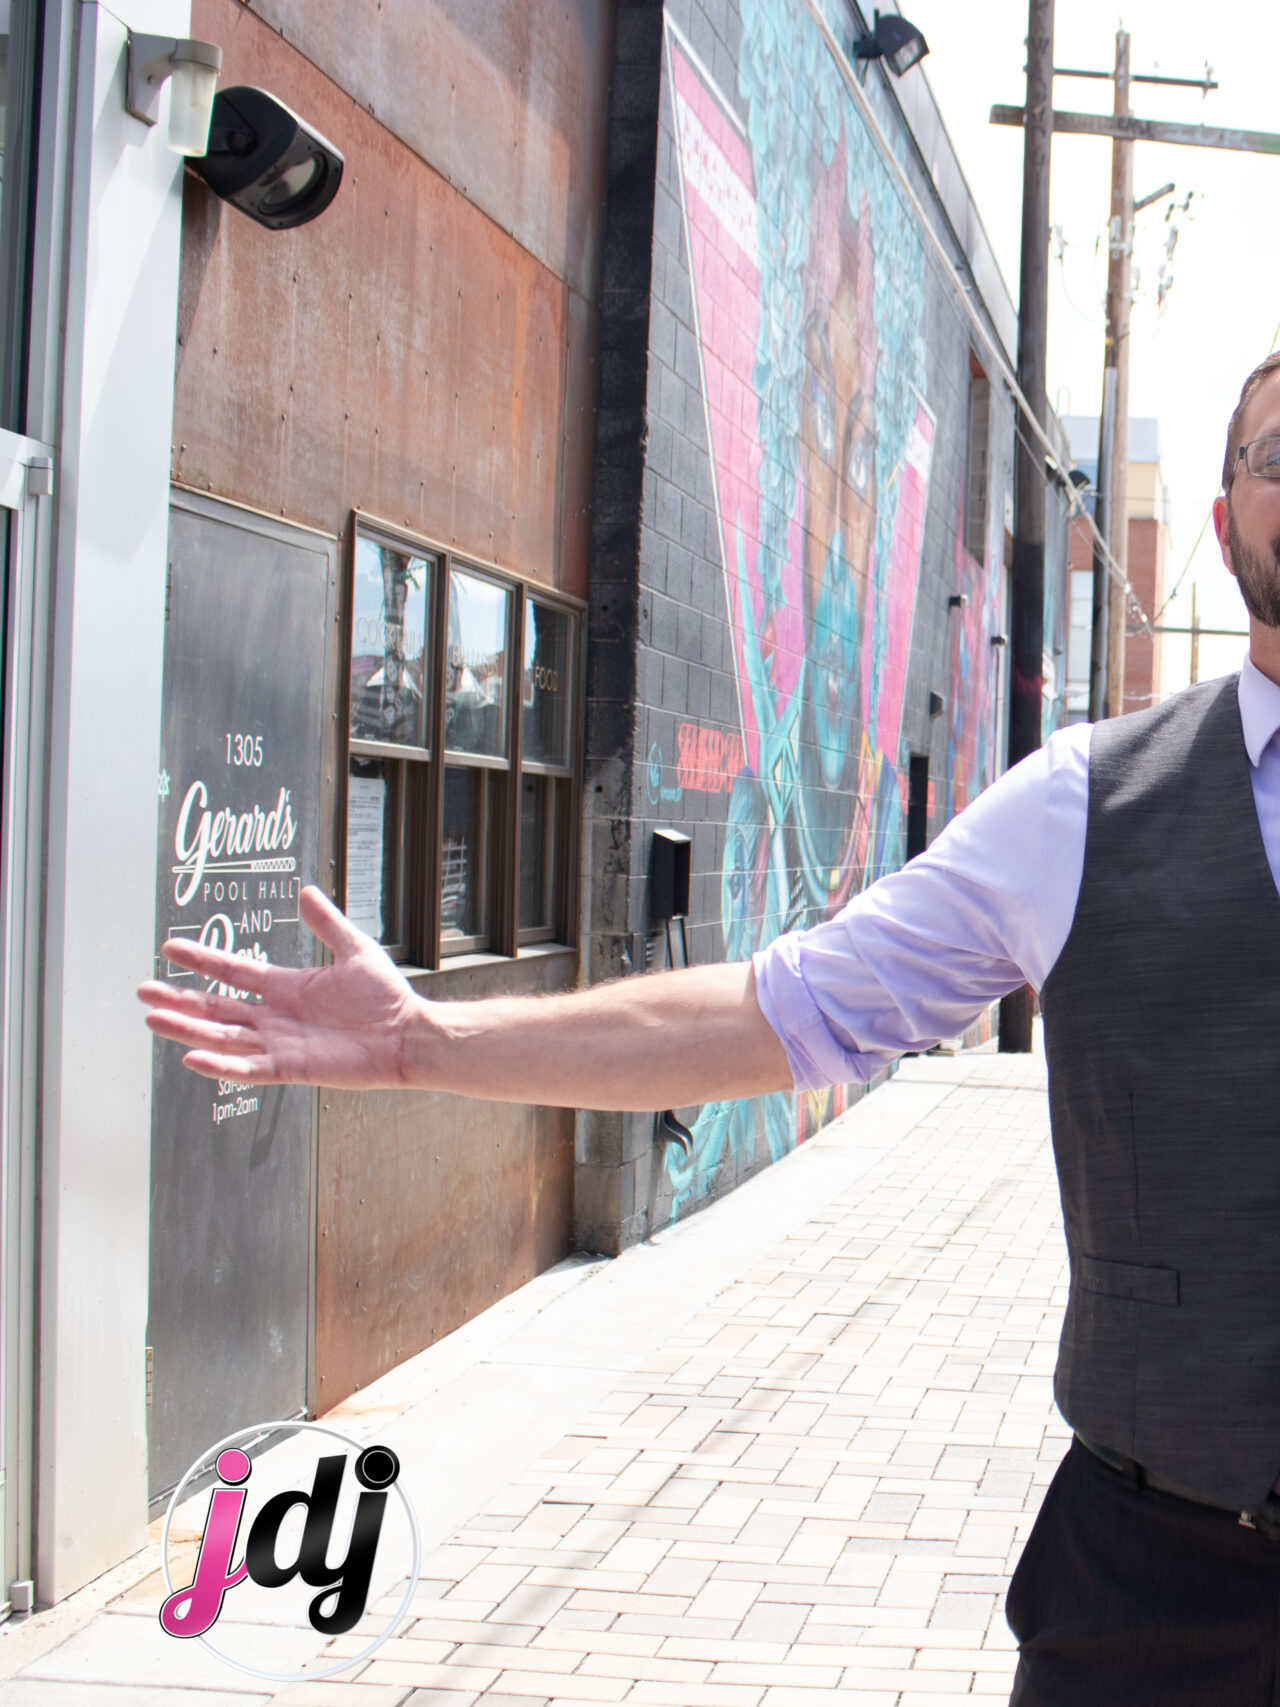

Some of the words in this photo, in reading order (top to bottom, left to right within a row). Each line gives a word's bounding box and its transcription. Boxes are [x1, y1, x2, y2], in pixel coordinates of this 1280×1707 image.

[534, 665, 559, 692] FOOD
[225, 733, 264, 767] 1305
[174, 781, 297, 906] Gerard's
[204, 881, 248, 902] POOL
[258, 878, 295, 900] HALL
[239, 909, 272, 934] AND
[212, 1096, 259, 1125] 1pm-2am
